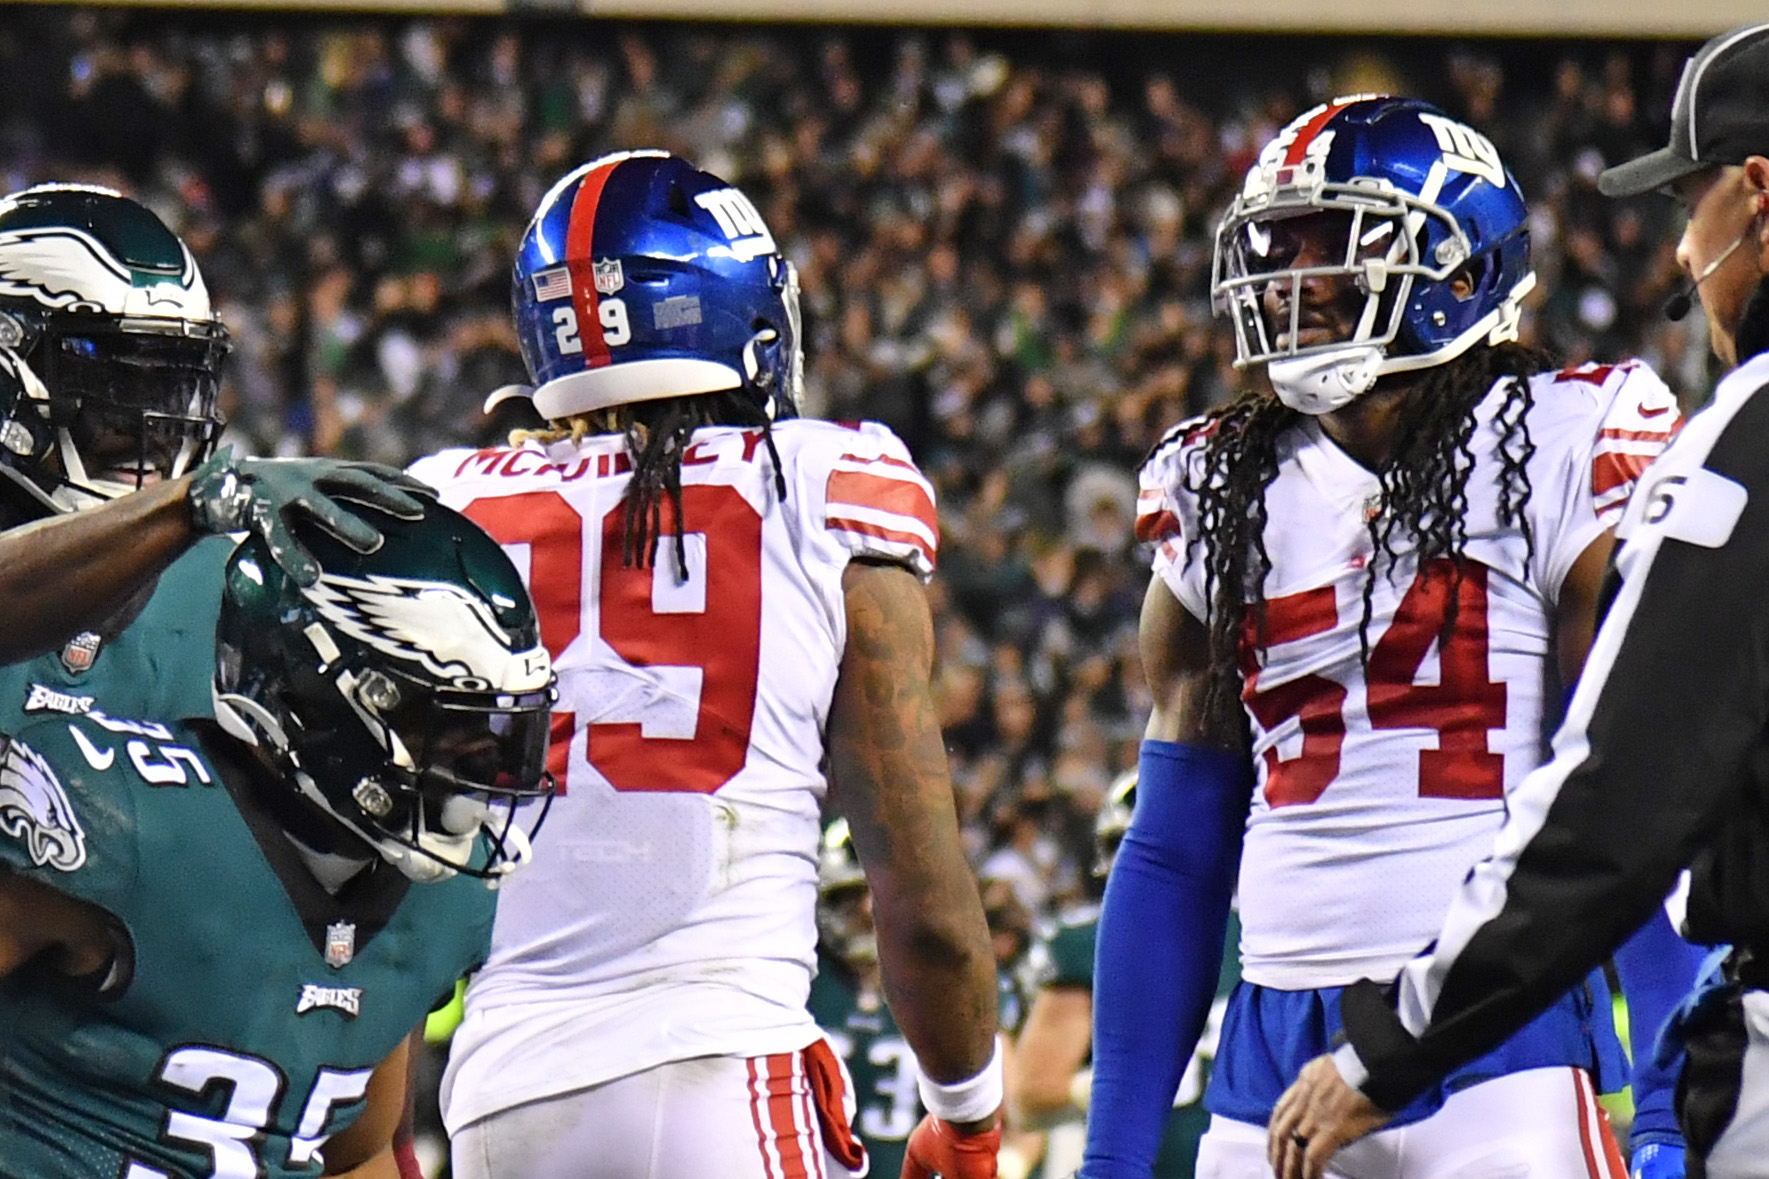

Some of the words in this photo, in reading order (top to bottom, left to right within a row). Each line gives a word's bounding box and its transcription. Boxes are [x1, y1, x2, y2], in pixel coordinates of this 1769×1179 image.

[552, 298, 631, 355] 29
[25, 683, 95, 715] EAGLES
[1238, 556, 1508, 810] 54
